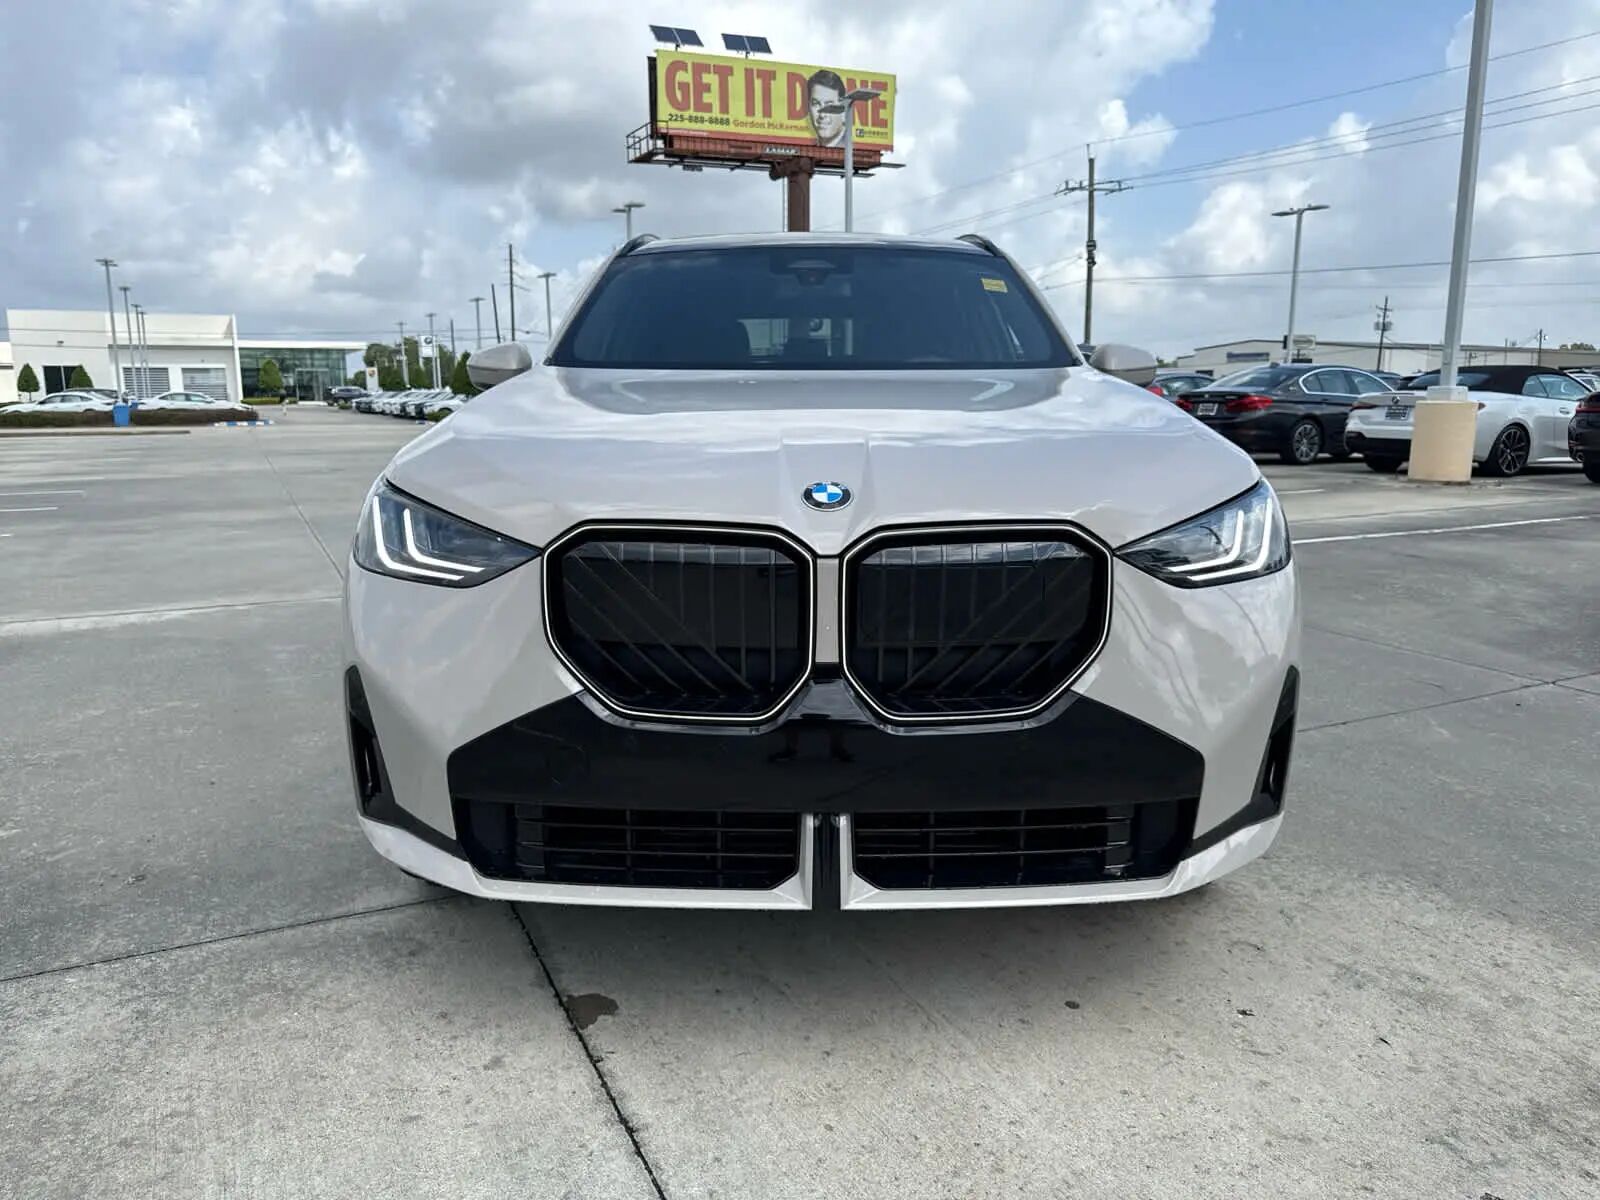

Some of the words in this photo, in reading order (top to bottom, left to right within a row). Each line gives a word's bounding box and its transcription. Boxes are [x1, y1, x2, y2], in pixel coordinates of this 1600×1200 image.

[665, 59, 734, 115] GET
[744, 68, 777, 118] IT
[787, 72, 888, 128] DNE
[668, 113, 730, 127] 225-888-8888
[733, 119, 765, 129] Gordon
